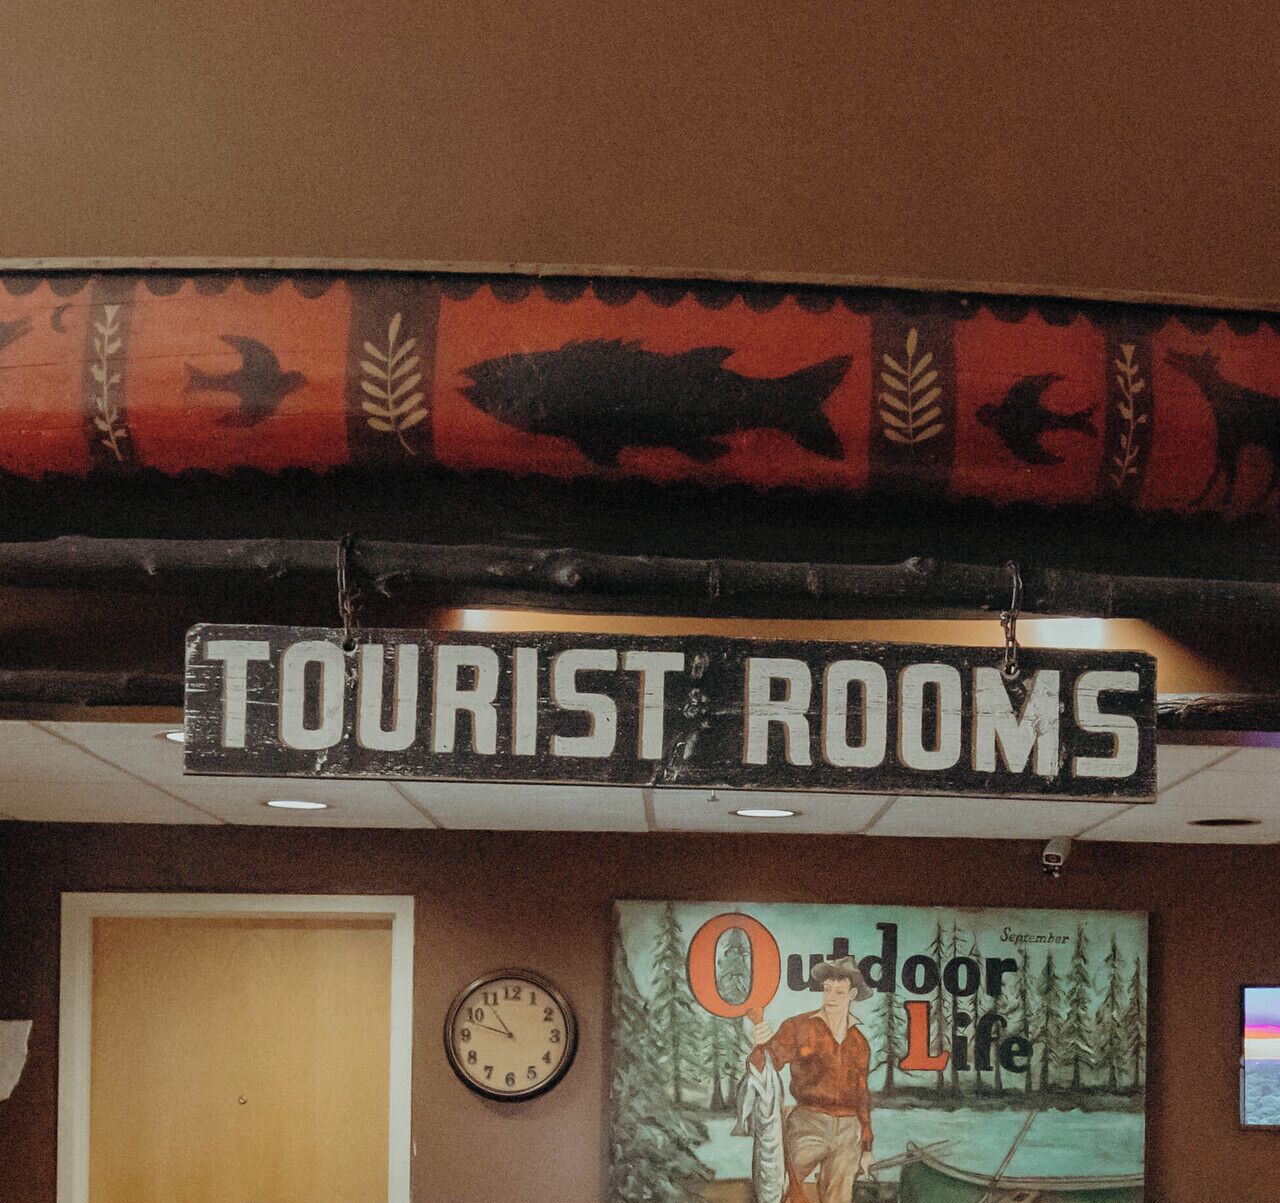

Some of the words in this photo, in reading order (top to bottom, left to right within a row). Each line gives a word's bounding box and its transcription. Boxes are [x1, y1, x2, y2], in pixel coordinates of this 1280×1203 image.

[203, 638, 685, 761] TOURIST
[742, 656, 1142, 778] ROOMS
[999, 926, 1071, 946] September
[686, 912, 1019, 1019] Outdoor
[484, 992, 498, 1005] 11
[503, 986, 521, 1000] 12
[529, 992, 537, 1005] 1
[466, 1007, 484, 1021] 10
[544, 1007, 554, 1021] 2
[461, 1028, 471, 1043] 9
[550, 1028, 560, 1043] 3
[898, 1000, 1034, 1074] Life
[468, 1050, 477, 1065] 8
[542, 1050, 551, 1064] 4
[484, 1065, 494, 1079] 7
[505, 1072, 515, 1086] 6
[527, 1066, 537, 1080] 5
